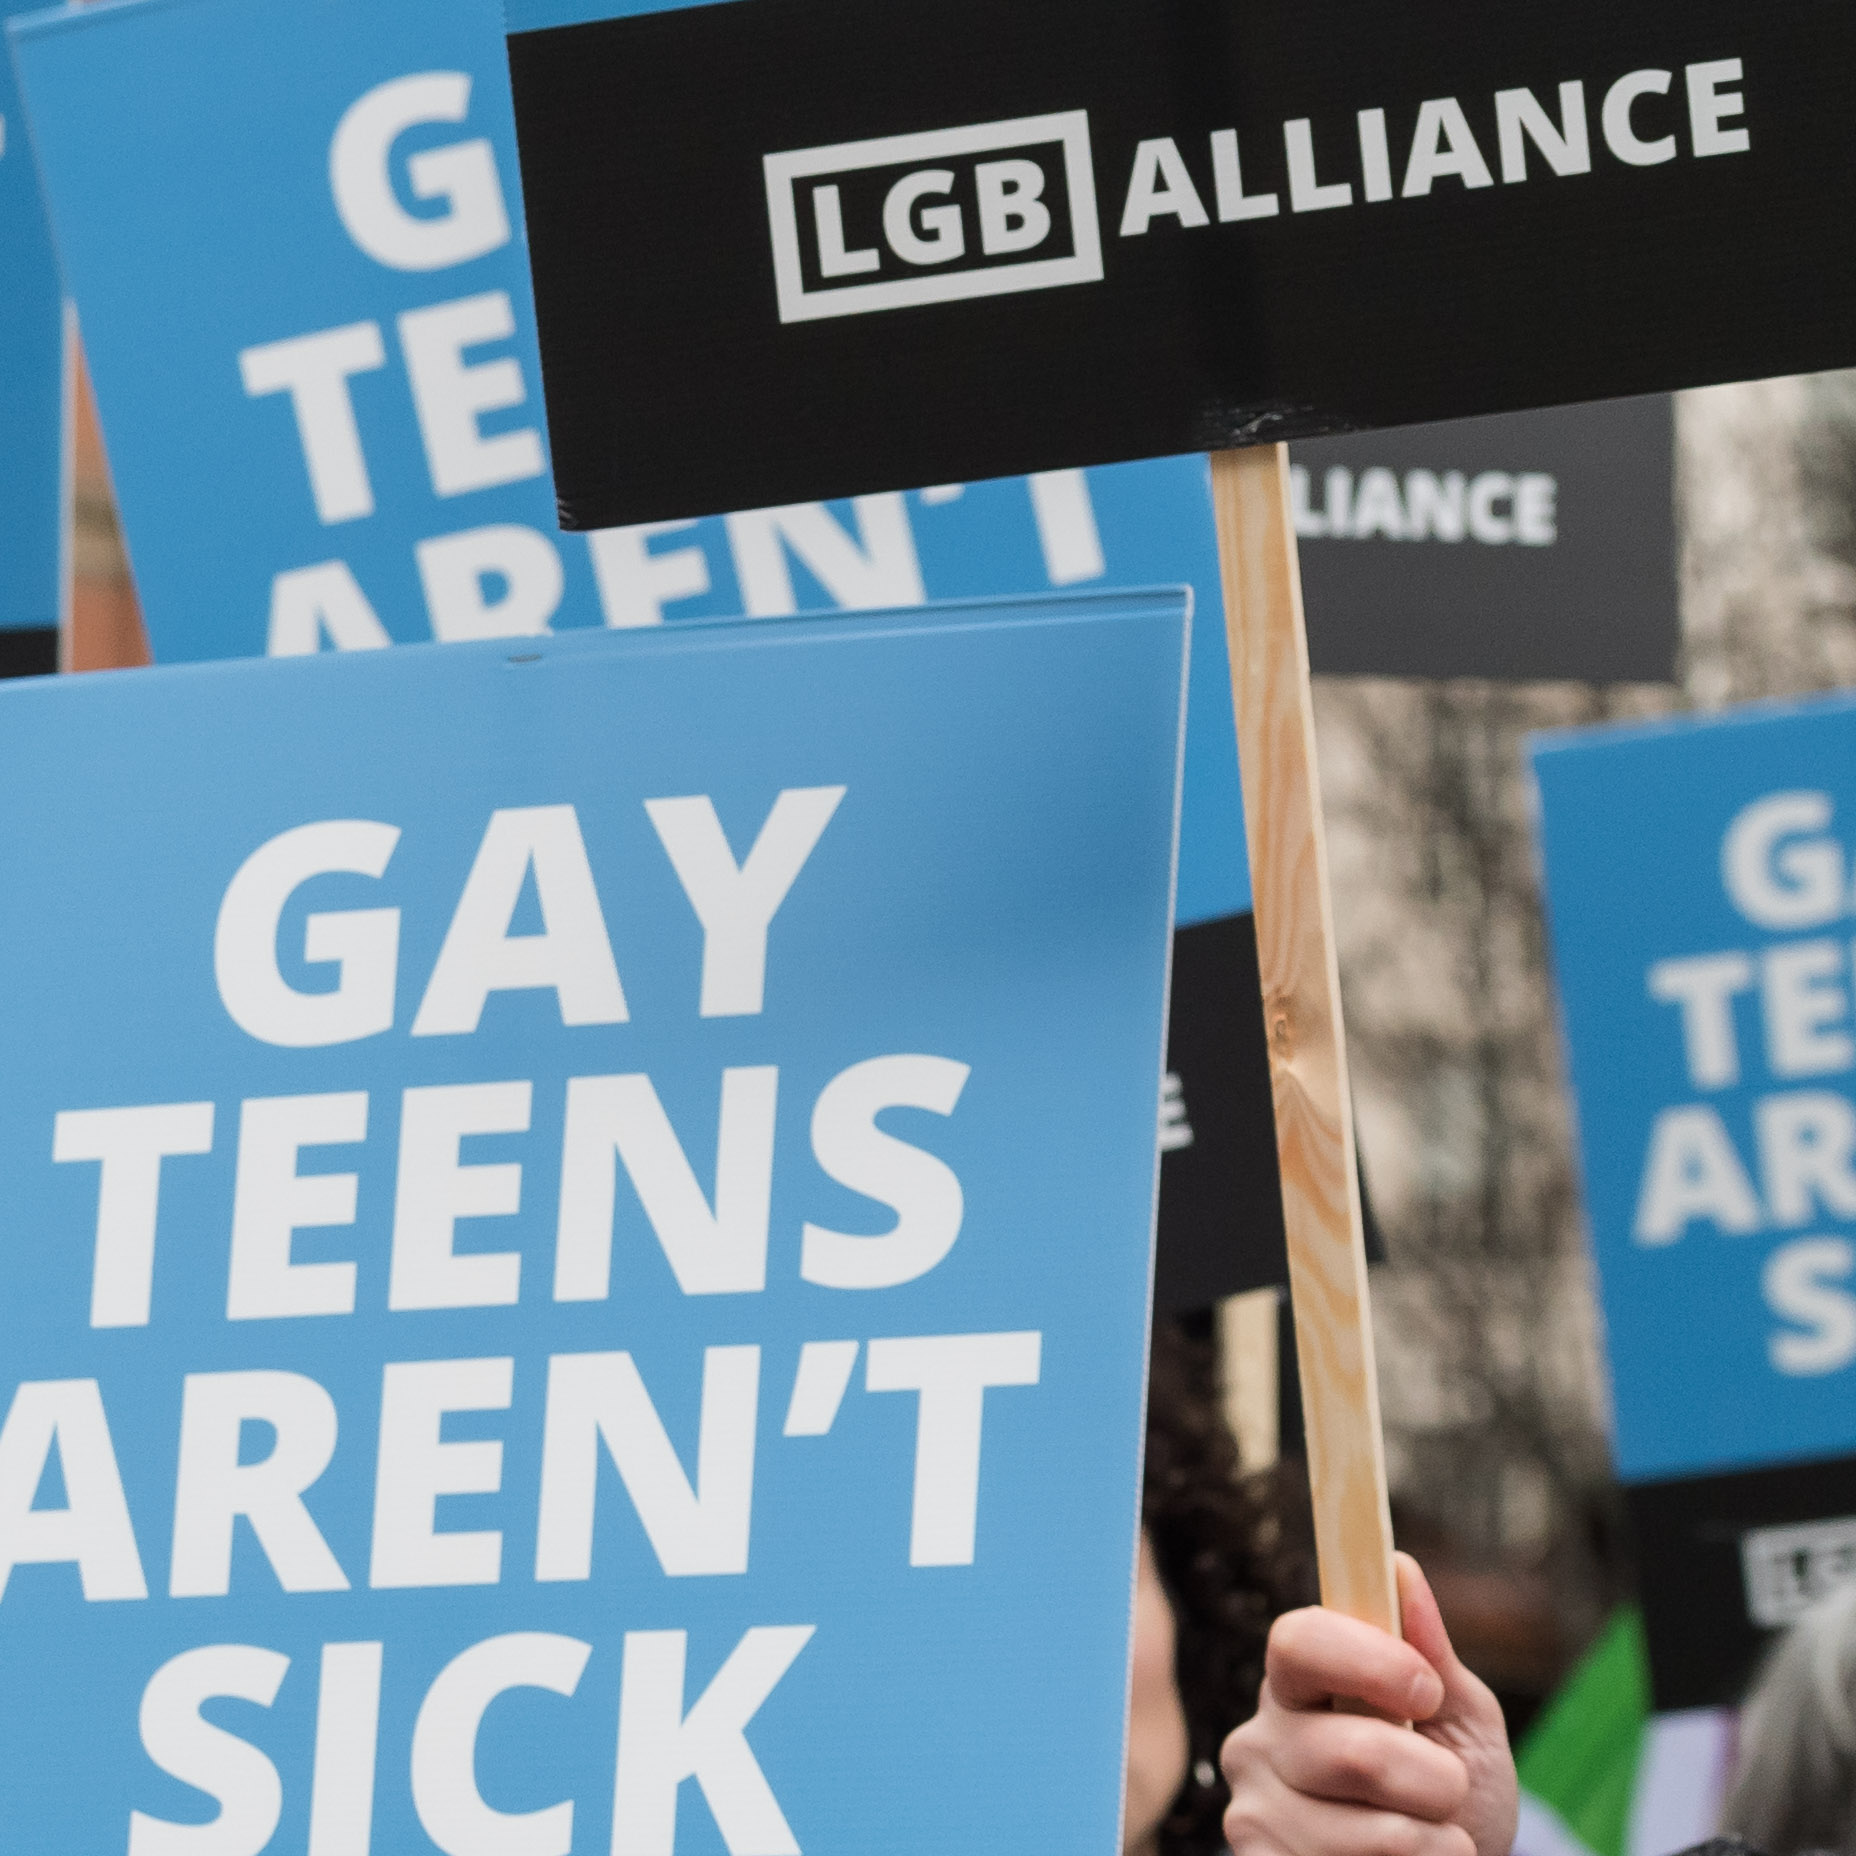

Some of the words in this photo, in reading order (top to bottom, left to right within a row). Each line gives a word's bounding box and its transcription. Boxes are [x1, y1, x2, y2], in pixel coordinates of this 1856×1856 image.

[811, 157, 1051, 278] LGB
[1119, 57, 1752, 237] ALLIANCE
[1288, 464, 1558, 547] LIANCE
[213, 783, 847, 1049] GAY
[50, 1053, 972, 1332] TEENS
